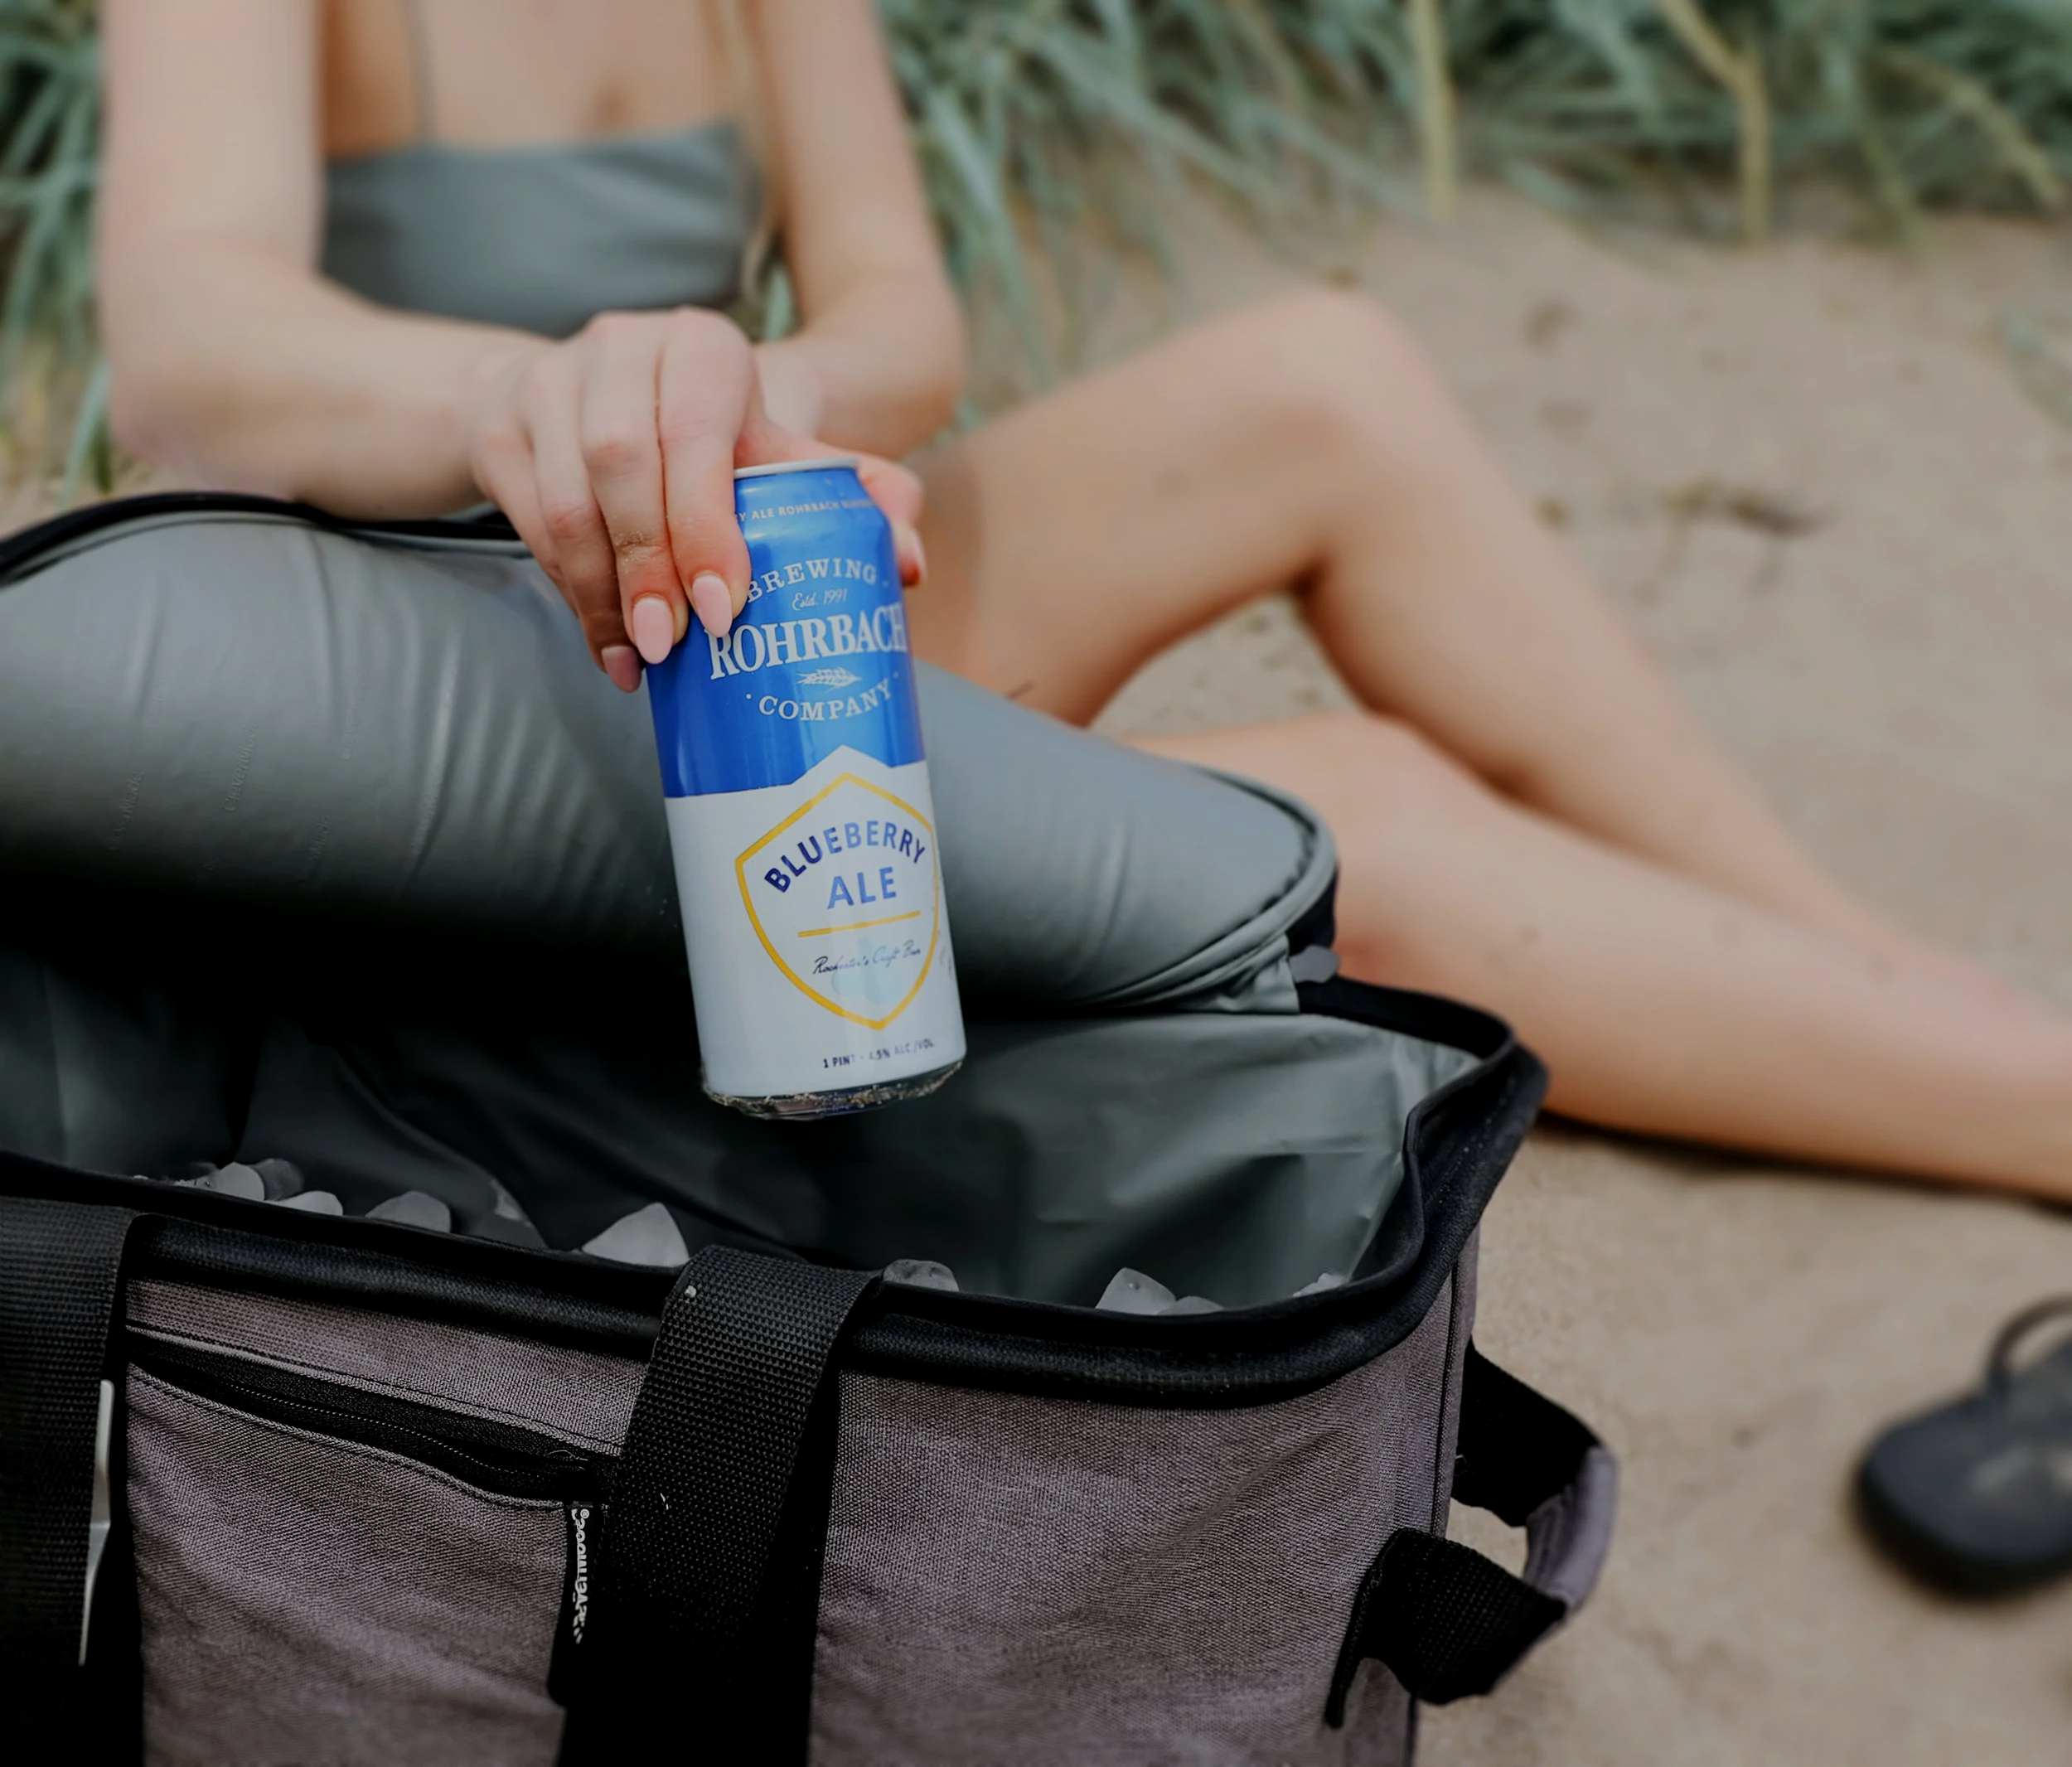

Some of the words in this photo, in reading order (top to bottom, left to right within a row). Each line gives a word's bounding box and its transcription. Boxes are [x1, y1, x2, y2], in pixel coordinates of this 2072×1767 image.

[751, 507, 776, 520] ALE
[748, 557, 877, 603] BREWING
[822, 587, 848, 606] 1991
[704, 602, 908, 680] ROHRBACH
[758, 678, 892, 722] COMPANY
[763, 820, 926, 893] BLUEBERRY
[826, 866, 898, 910] ALE
[823, 1058, 830, 1069] 1
[832, 1054, 855, 1067] PINT
